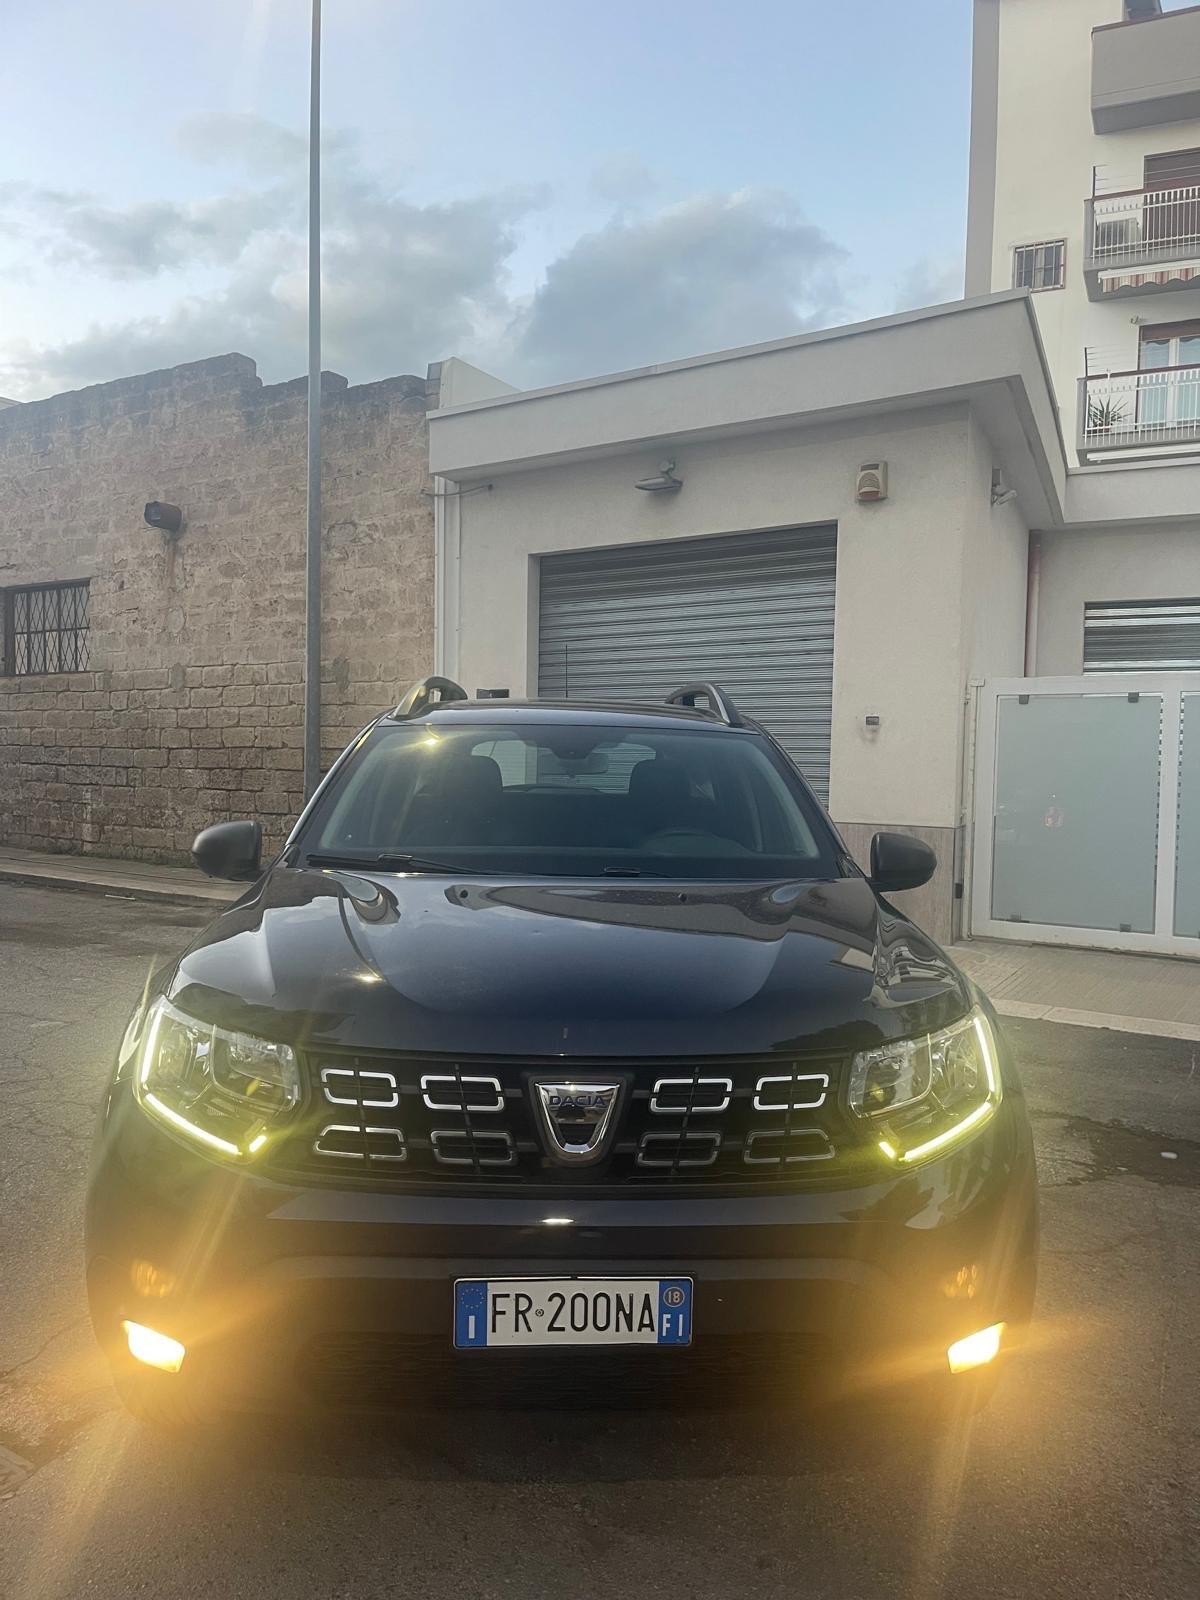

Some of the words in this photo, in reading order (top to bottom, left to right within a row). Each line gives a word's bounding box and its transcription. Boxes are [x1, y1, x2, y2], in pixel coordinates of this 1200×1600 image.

[549, 1095, 606, 1106] DACIA
[668, 1291, 680, 1302] 18
[491, 1293, 533, 1333] FR
[547, 1291, 655, 1332] 200NA
